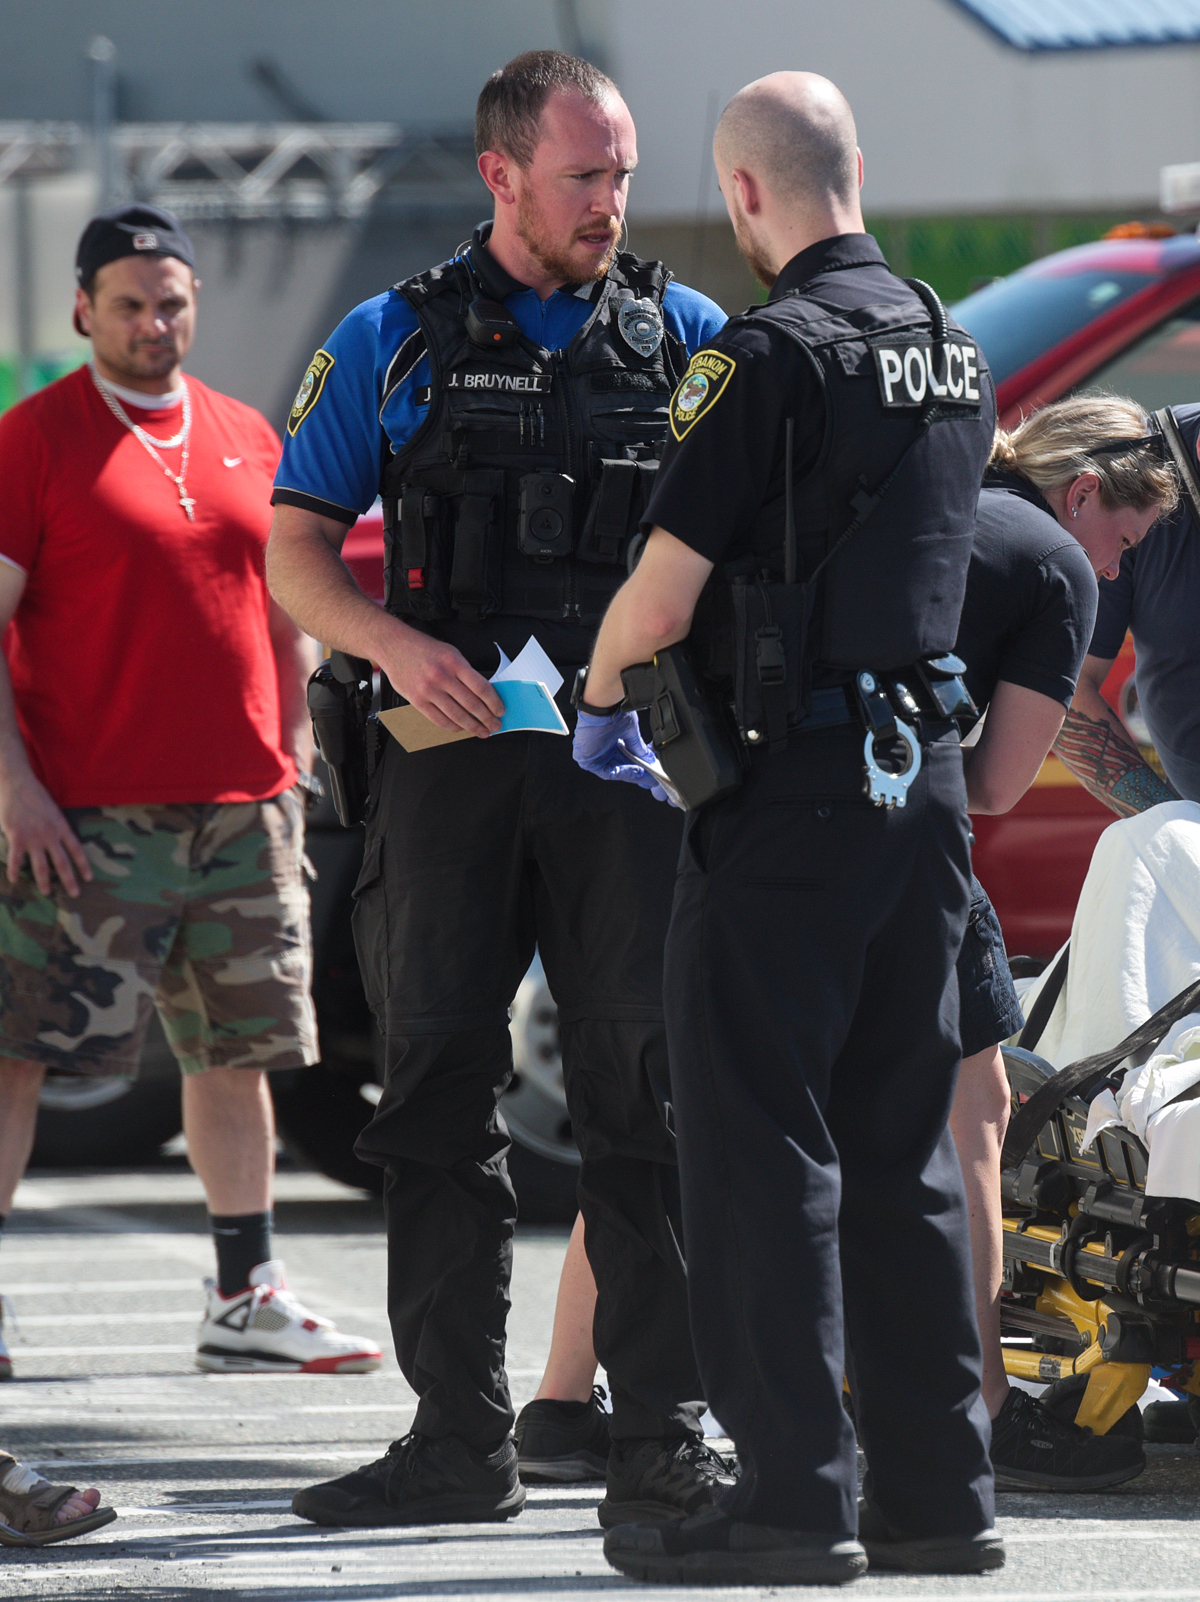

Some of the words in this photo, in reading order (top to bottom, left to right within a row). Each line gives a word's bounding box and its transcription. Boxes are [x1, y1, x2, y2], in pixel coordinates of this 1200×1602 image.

[448, 373, 459, 387] J.
[464, 373, 543, 392] BRUYNELL
[675, 405, 698, 421] POLICE
